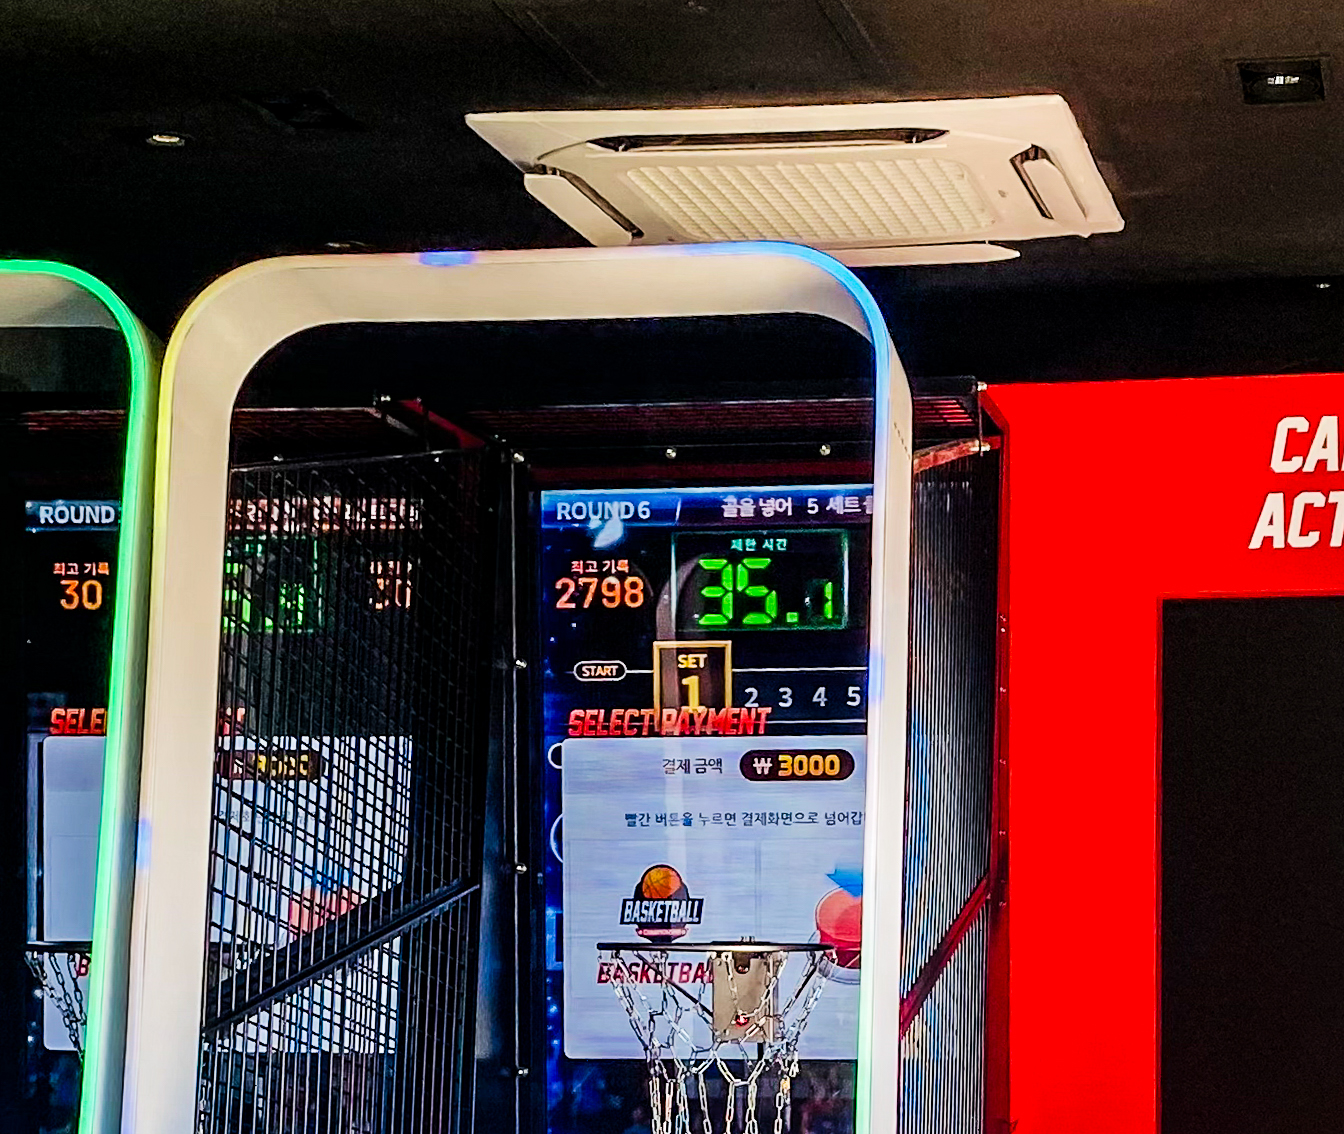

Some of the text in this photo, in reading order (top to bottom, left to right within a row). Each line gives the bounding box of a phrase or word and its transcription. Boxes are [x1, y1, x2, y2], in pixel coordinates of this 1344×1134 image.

[39, 504, 116, 524] ROUND
[759, 496, 792, 518] 넣어
[807, 497, 819, 515] 5
[762, 538, 788, 552] 시간
[53, 562, 109, 576] 최고 기록
[571, 559, 630, 574] 최고 기록
[60, 579, 103, 610] 30
[554, 575, 644, 609] 2798
[697, 556, 834, 626] 35.1
[581, 664, 619, 678] START
[677, 653, 708, 669] SET
[680, 675, 701, 713] 1
[744, 686, 861, 708] 2 3 4 5
[49, 707, 107, 735] SELE
[568, 706, 772, 736] SELECT PAYMENT
[662, 758, 723, 775] 결제 금액
[777, 754, 841, 777] 3000
[624, 810, 865, 828] 빨간 버튼을 누르면 결제화면으로 넘어갑
[623, 900, 700, 924] BASKETBALL
